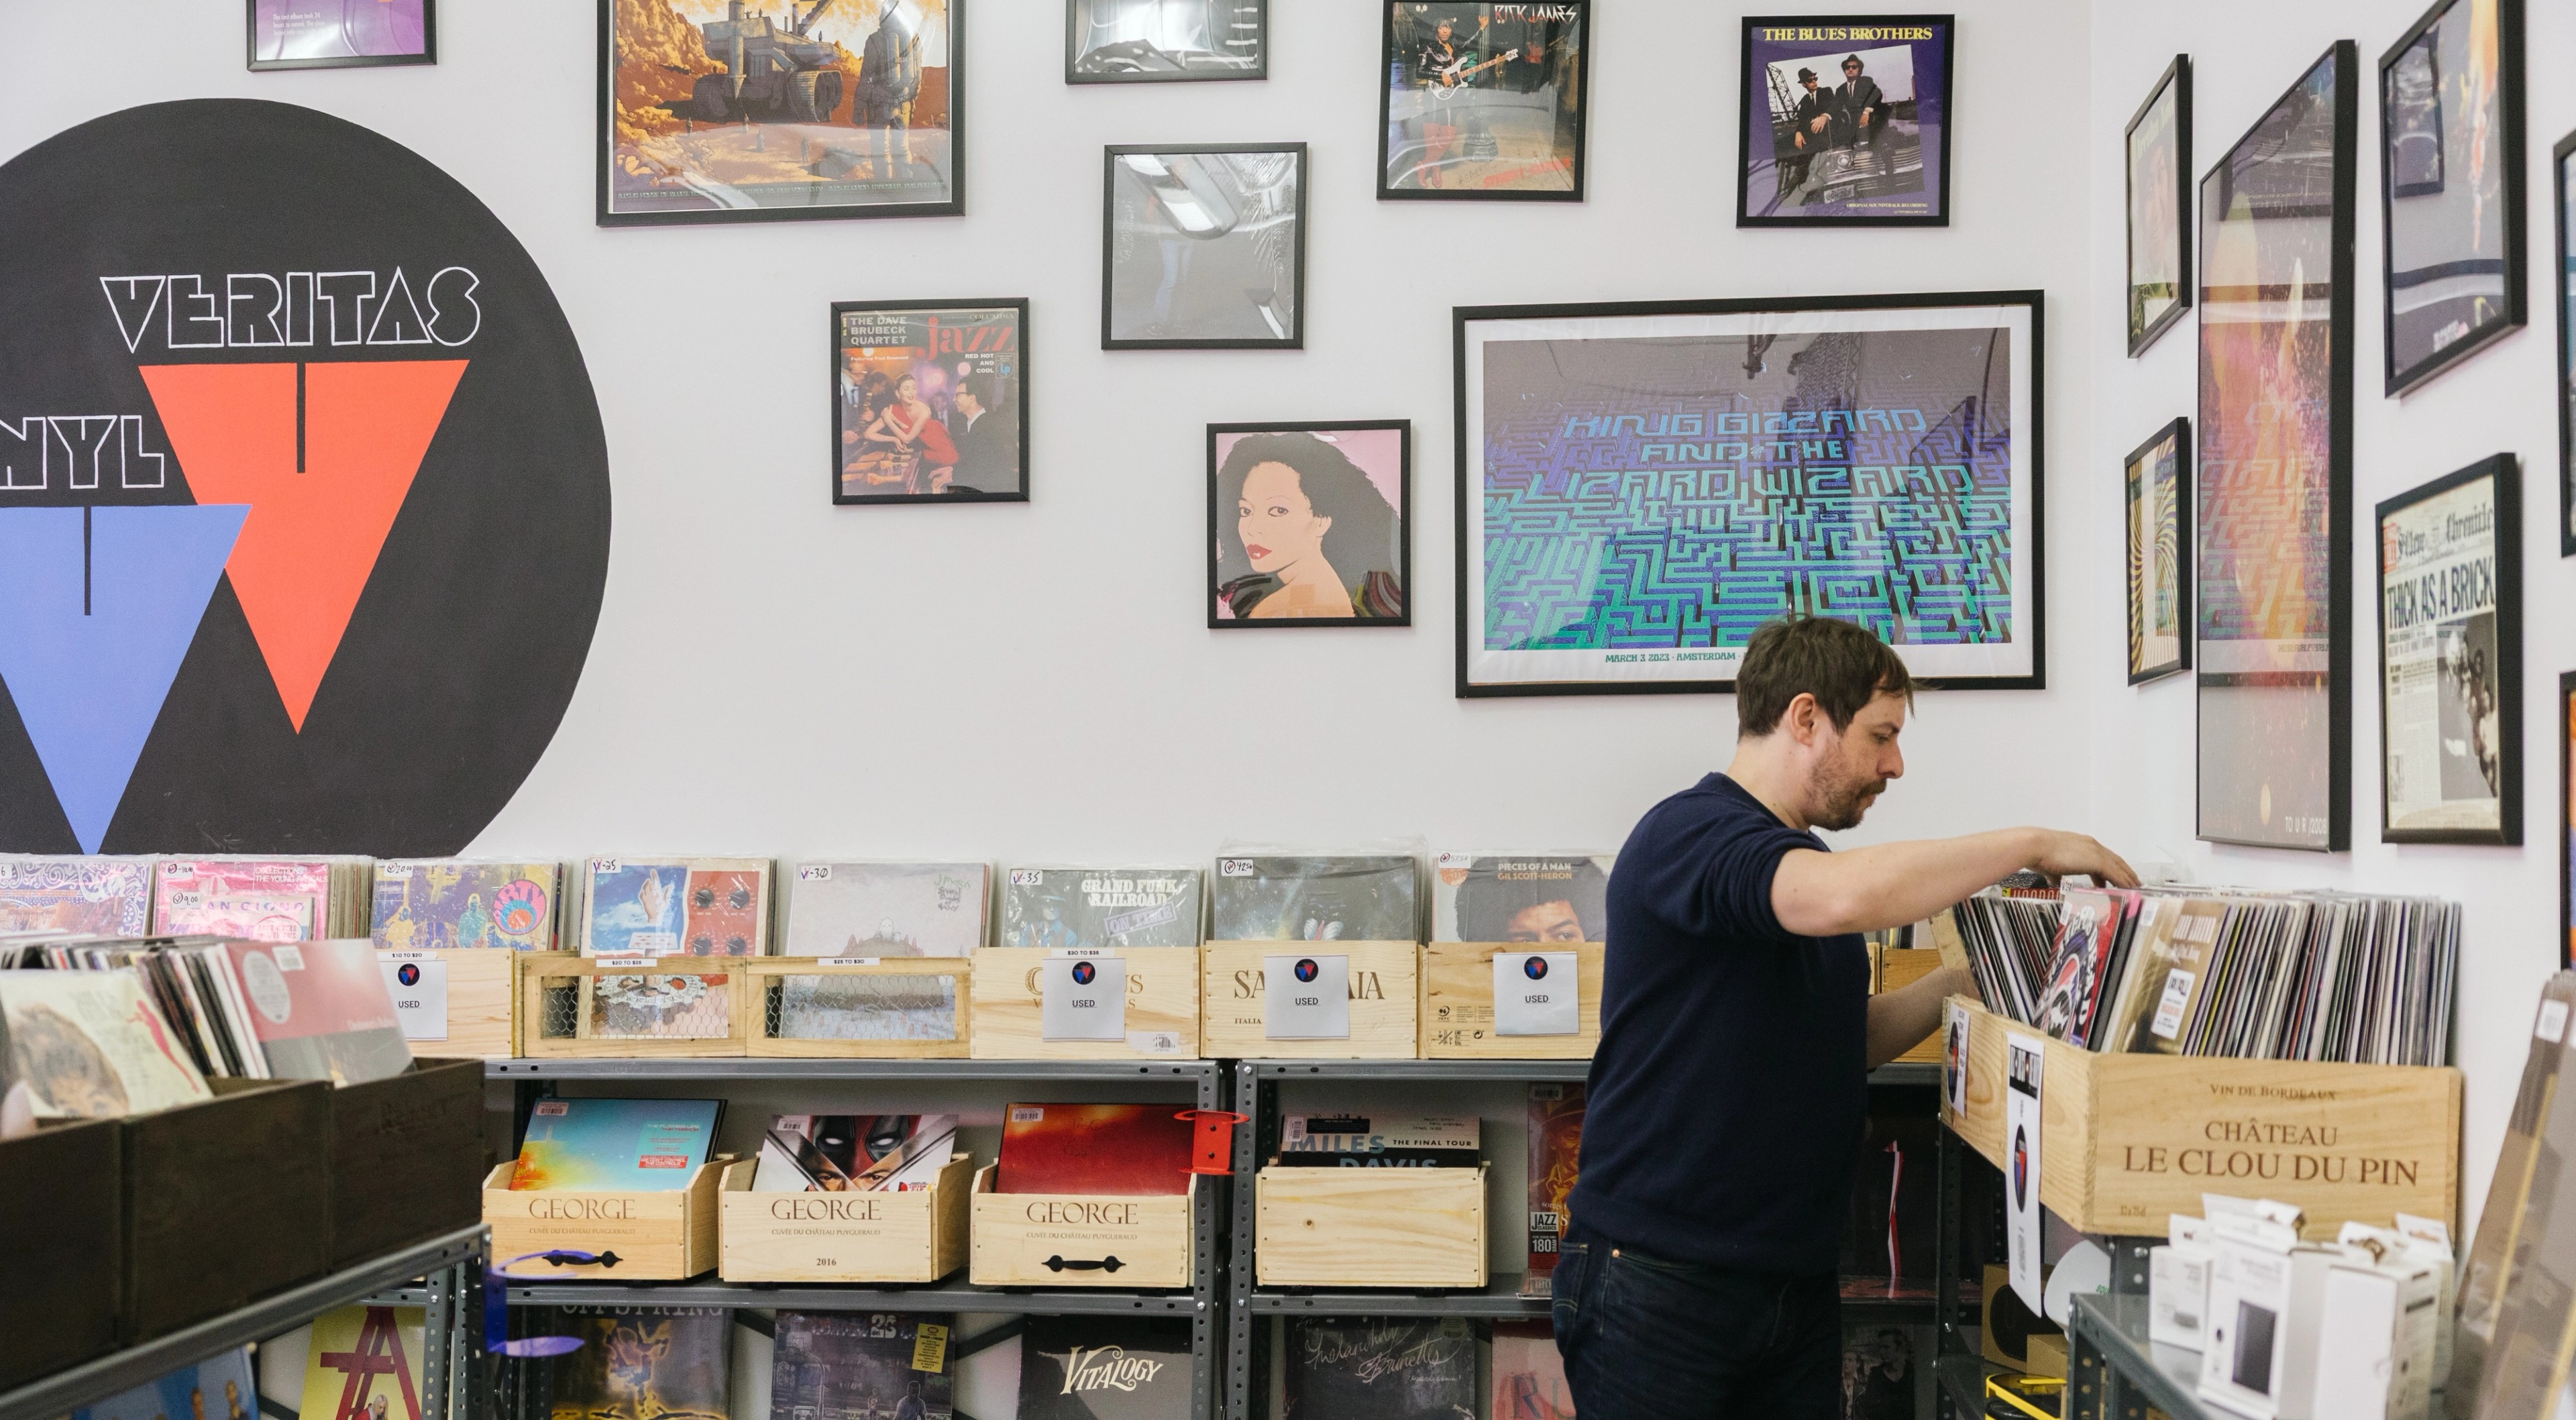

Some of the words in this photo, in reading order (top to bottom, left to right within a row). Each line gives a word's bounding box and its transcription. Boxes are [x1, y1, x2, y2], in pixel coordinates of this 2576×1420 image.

[1495, 5, 1527, 24] RICK
[1528, 5, 1576, 24] JAMES
[1763, 28, 1796, 40] THE
[1799, 28, 1847, 40] BLUES
[1849, 28, 1933, 40] BROTHERS
[99, 266, 481, 353] VERITAS
[851, 317, 873, 325] THE
[877, 317, 907, 325] DAVE
[851, 326, 906, 335] BRUBECK
[851, 335, 907, 345] QUARTET
[916, 315, 1017, 362] jazz
[1564, 414, 1703, 437] KING
[1717, 410, 1928, 435] GIZZARD
[1641, 443, 1748, 463] AND
[1765, 441, 1844, 461] THE
[1526, 471, 1736, 501] LIZARD
[1754, 466, 1974, 496] WIZARD
[2387, 578, 2418, 629] THICK
[2422, 572, 2437, 622] AS
[2440, 569, 2448, 618] A
[2452, 555, 2496, 614] BRICK
[1605, 655, 1638, 663] MARCH
[1640, 654, 1646, 662] 3
[1648, 653, 1670, 661] 2023
[1676, 652, 1736, 661] AMSTERDAM
[255, 867, 304, 875] COLLECTIONS
[1498, 863, 1527, 871] PIECES
[1528, 863, 1542, 871] OF
[1542, 863, 1550, 871] A
[1550, 863, 1571, 871] MAN
[1497, 872, 1511, 880] GIL
[1513, 872, 1572, 881] SCOTT-HERON
[1081, 879, 1134, 893] GRAND
[1136, 879, 1178, 893] FUNK
[1088, 893, 1167, 907] RAILROAD
[1109, 916, 1132, 933] ON
[398, 1000, 421, 1009] USED
[1072, 999, 1097, 1008] USED
[1295, 997, 1319, 1005] USED
[1525, 995, 1549, 1003] USED
[2210, 1084, 2235, 1096] VIN
[2238, 1085, 2257, 1097] DE
[2260, 1085, 2337, 1101] BORDEAUX
[2204, 1117, 2339, 1147] CHÂTEAU
[1289, 1134, 1385, 1154] MILES
[2124, 1145, 2168, 1174] LE
[2178, 1148, 2281, 1181] CLOU
[2293, 1154, 2348, 1183] DU
[2359, 1157, 2420, 1188] PIN
[529, 1198, 637, 1220] GEORGE
[771, 1199, 882, 1221] GEORGE
[1026, 1201, 1139, 1225] GEORGE
[1542, 1202, 1562, 1212] songs
[1532, 1213, 1557, 1231] JAZZ
[1532, 1239, 1552, 1253] 180
[816, 1258, 837, 1266] 2016
[1059, 1345, 1165, 1395] VITALOGY
